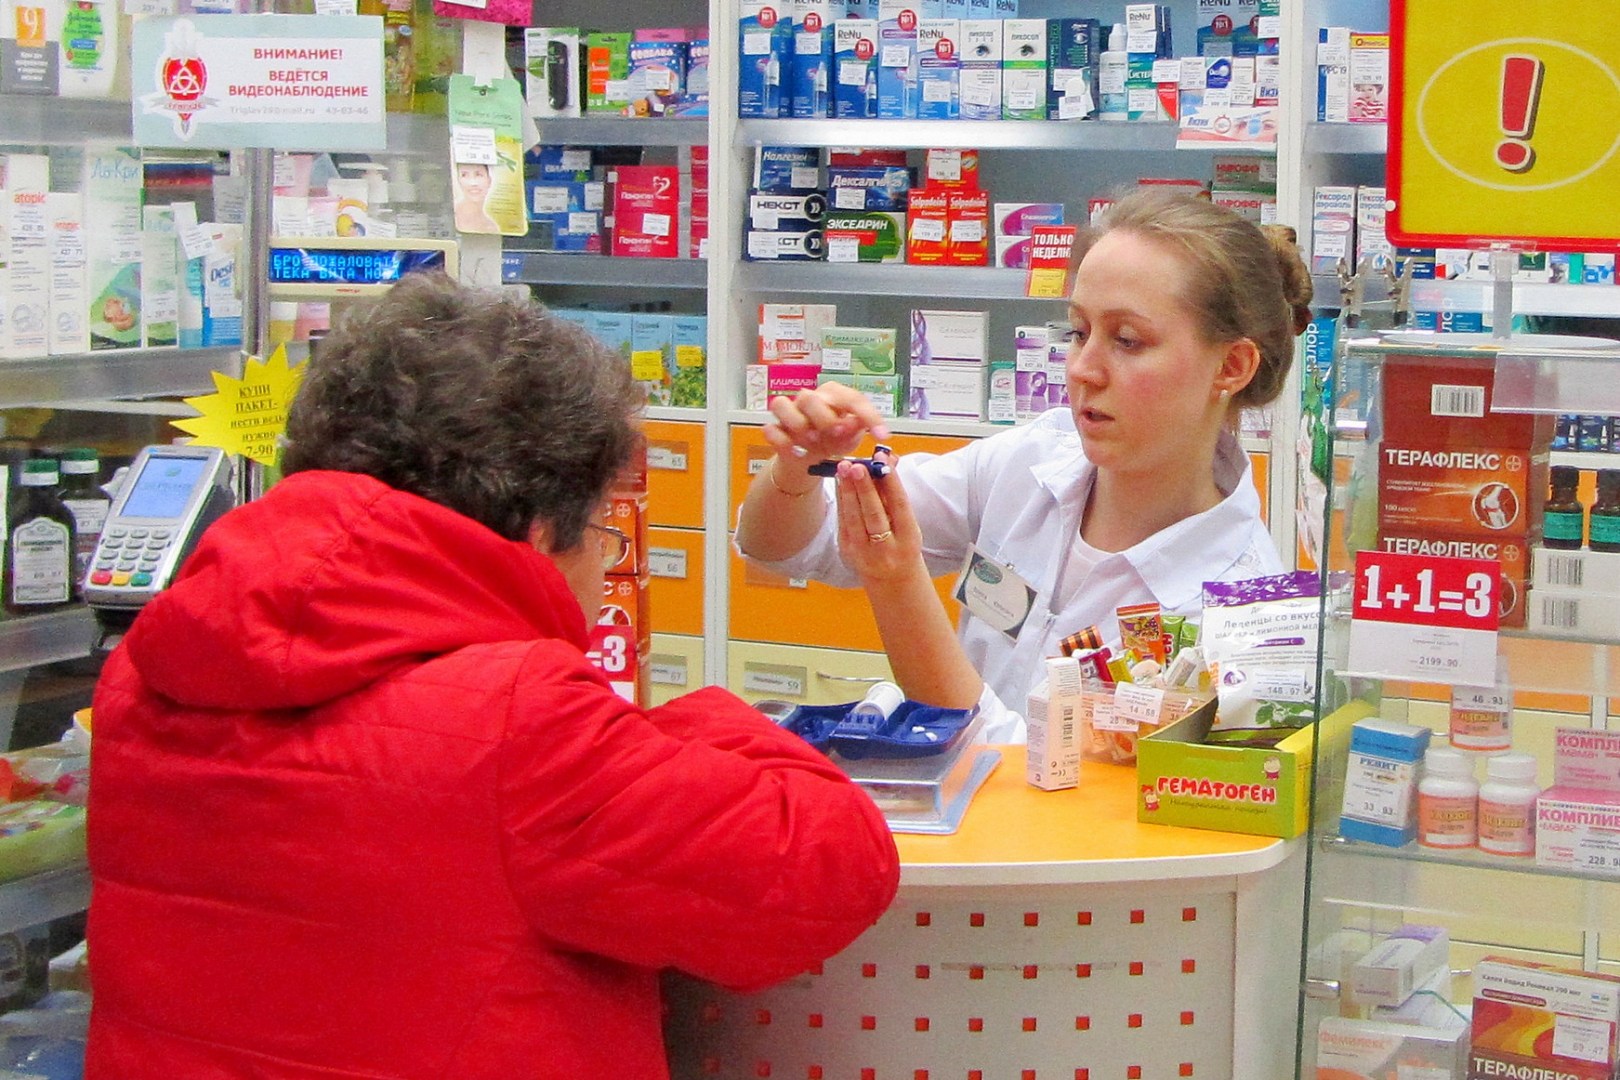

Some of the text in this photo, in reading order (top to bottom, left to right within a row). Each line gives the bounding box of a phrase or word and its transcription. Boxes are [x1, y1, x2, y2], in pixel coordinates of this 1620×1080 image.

[837, 29, 862, 39] ReNu
[920, 29, 944, 39] ReNu
[253, 48, 343, 60] ВНИМАНИЕ!
[268, 68, 329, 84] ВЕДЁТСЯ
[228, 85, 369, 99] ВИДЕОНАБЛЮДЕНИЕ
[13, 192, 46, 204] atopic
[826, 218, 889, 230] ЭКСЕДРИН
[1034, 233, 1074, 245] ТОЛЬКО
[274, 267, 310, 280] ТЕКА
[763, 340, 822, 352] МАМОКЛА
[239, 384, 271, 399] КУПИ
[235, 398, 279, 413] ПАКЕТ-
[246, 444, 274, 456] 7-90
[1385, 448, 1500, 471] ТЕРАФЛЕКС
[1383, 537, 1498, 559] ТЕРАФЛЕКС
[1360, 564, 1493, 618] 1+1=3
[1419, 656, 1459, 668] 2199 90
[1267, 686, 1301, 696] 148 97
[1472, 694, 1484, 704] 46
[1359, 757, 1399, 771] РЕВИТ
[1157, 776, 1277, 804] ГЕМАТОГЕН
[1587, 855, 1605, 865] 228
